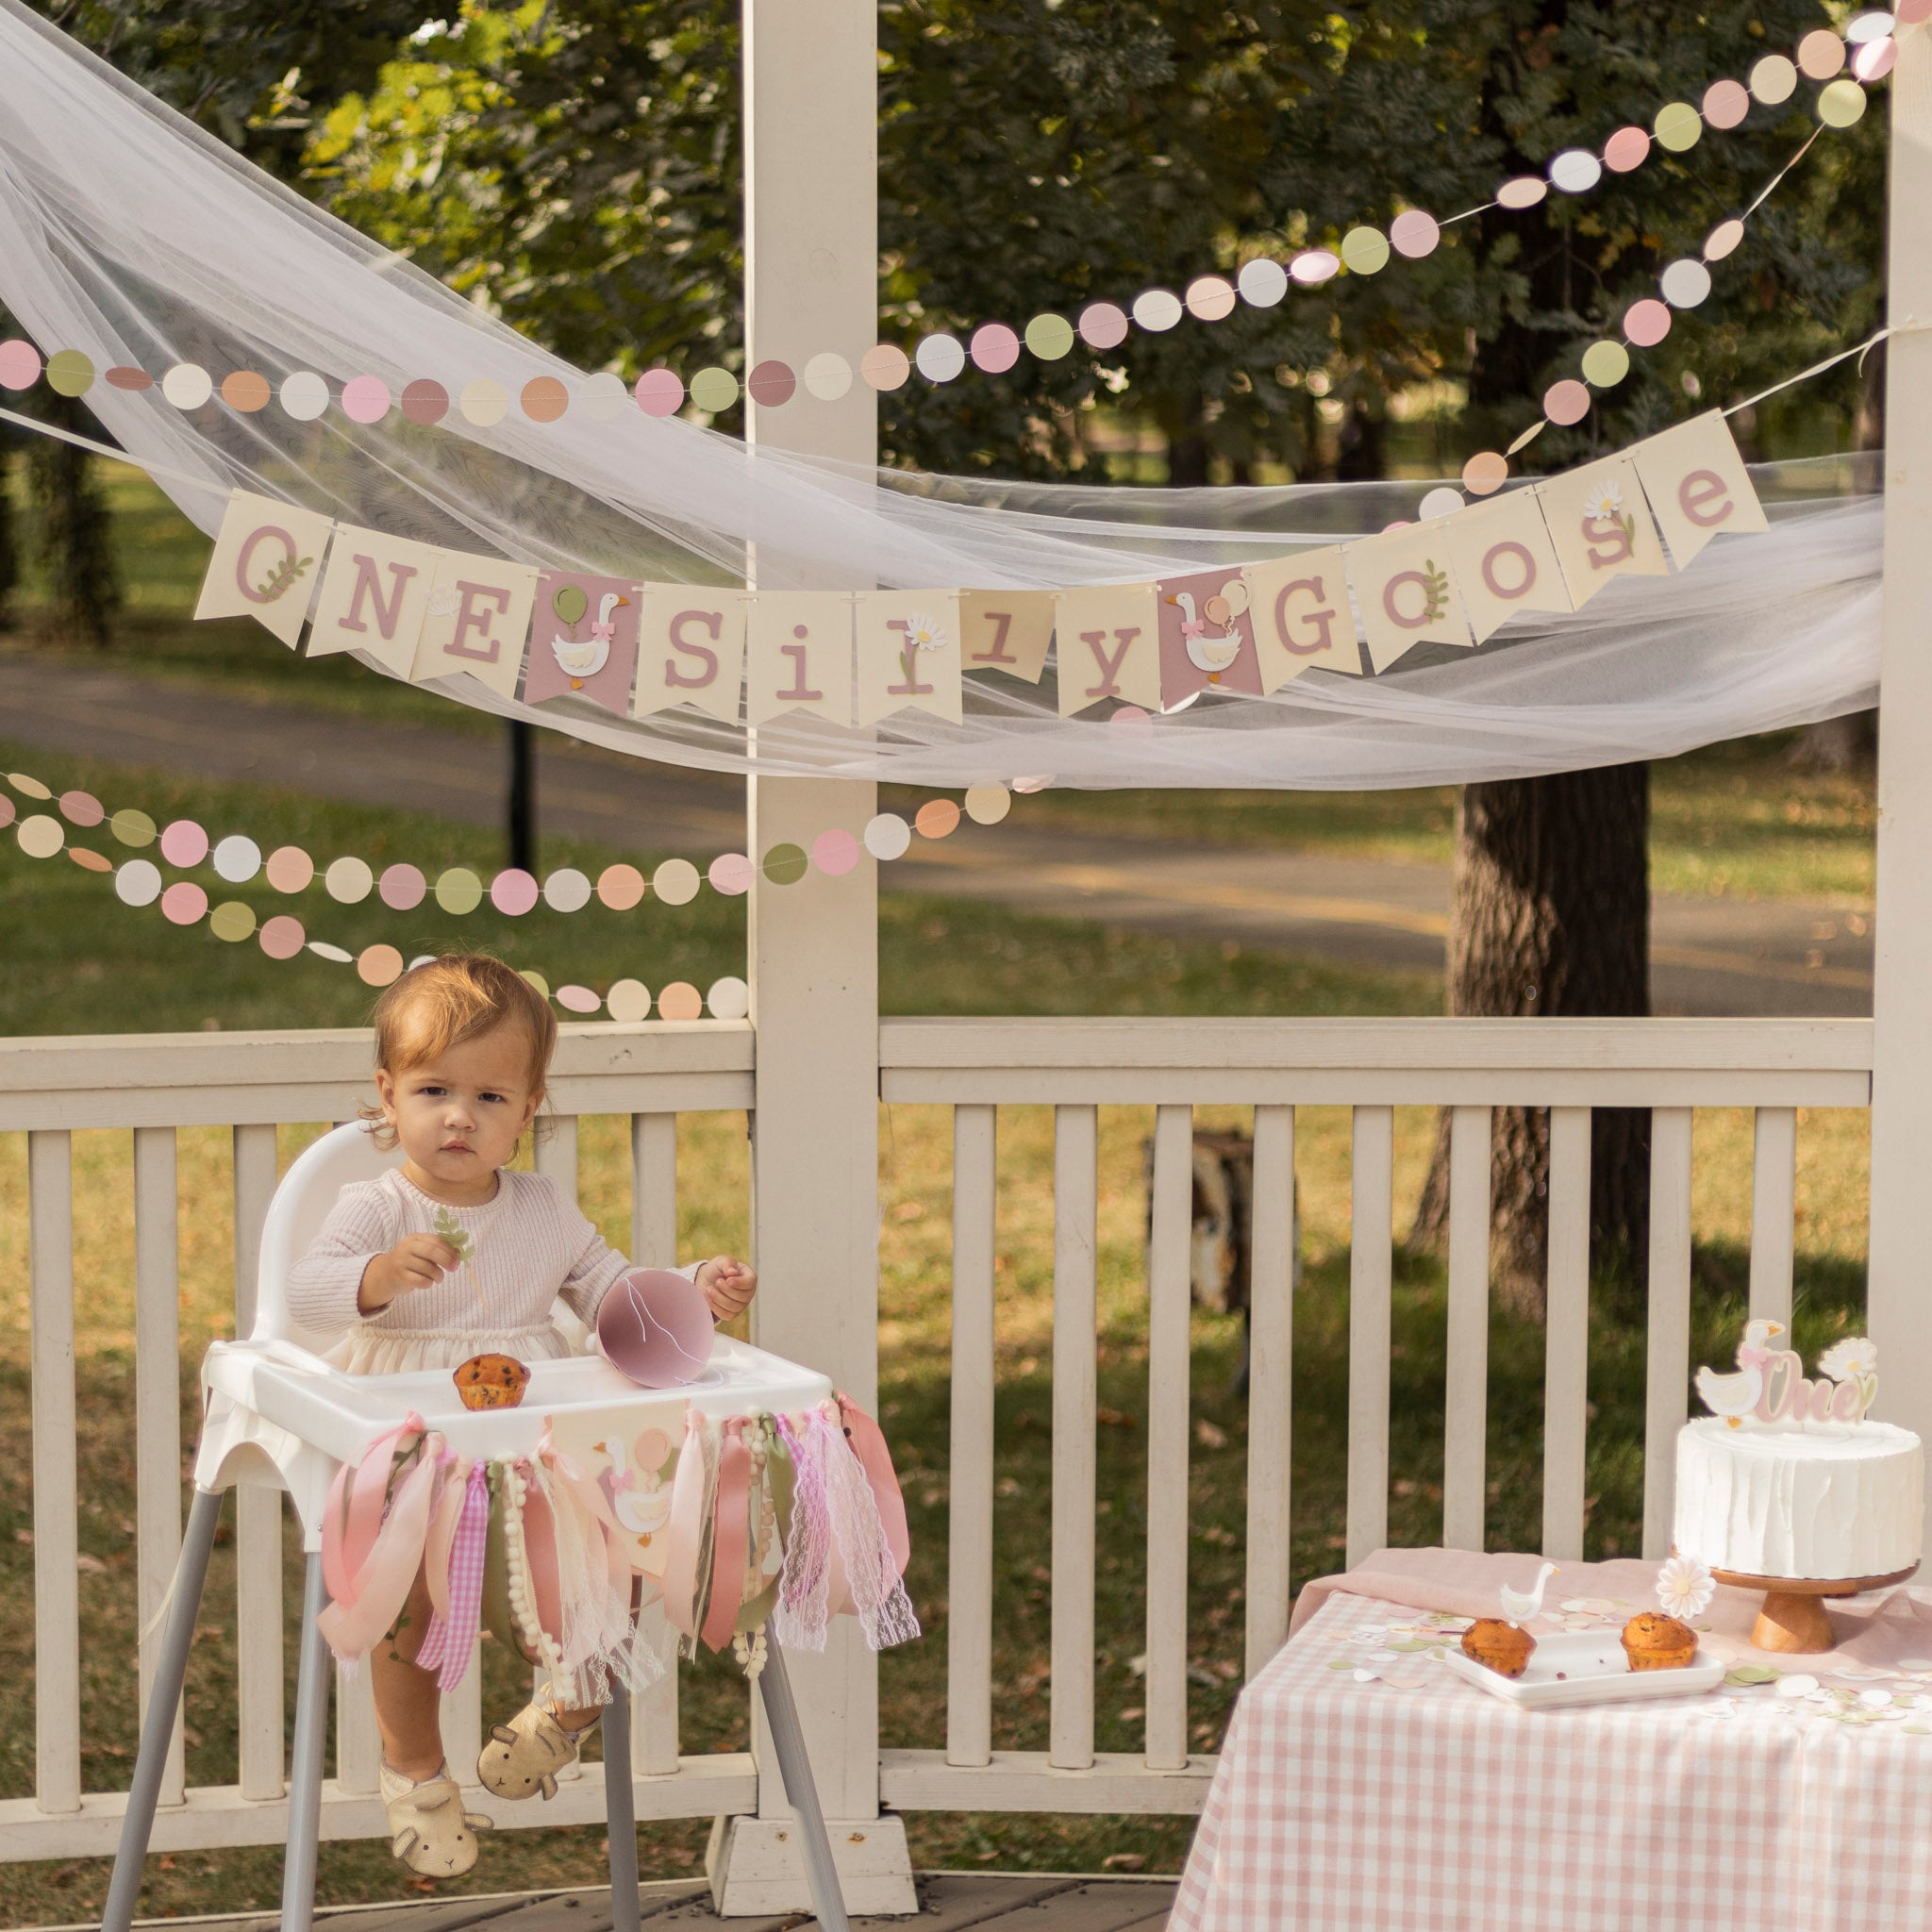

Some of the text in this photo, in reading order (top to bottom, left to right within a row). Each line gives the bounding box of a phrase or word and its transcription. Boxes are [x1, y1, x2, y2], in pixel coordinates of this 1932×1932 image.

[237, 468, 1735, 700] ONE Silly Goose
[1754, 1353, 1863, 1424] One
